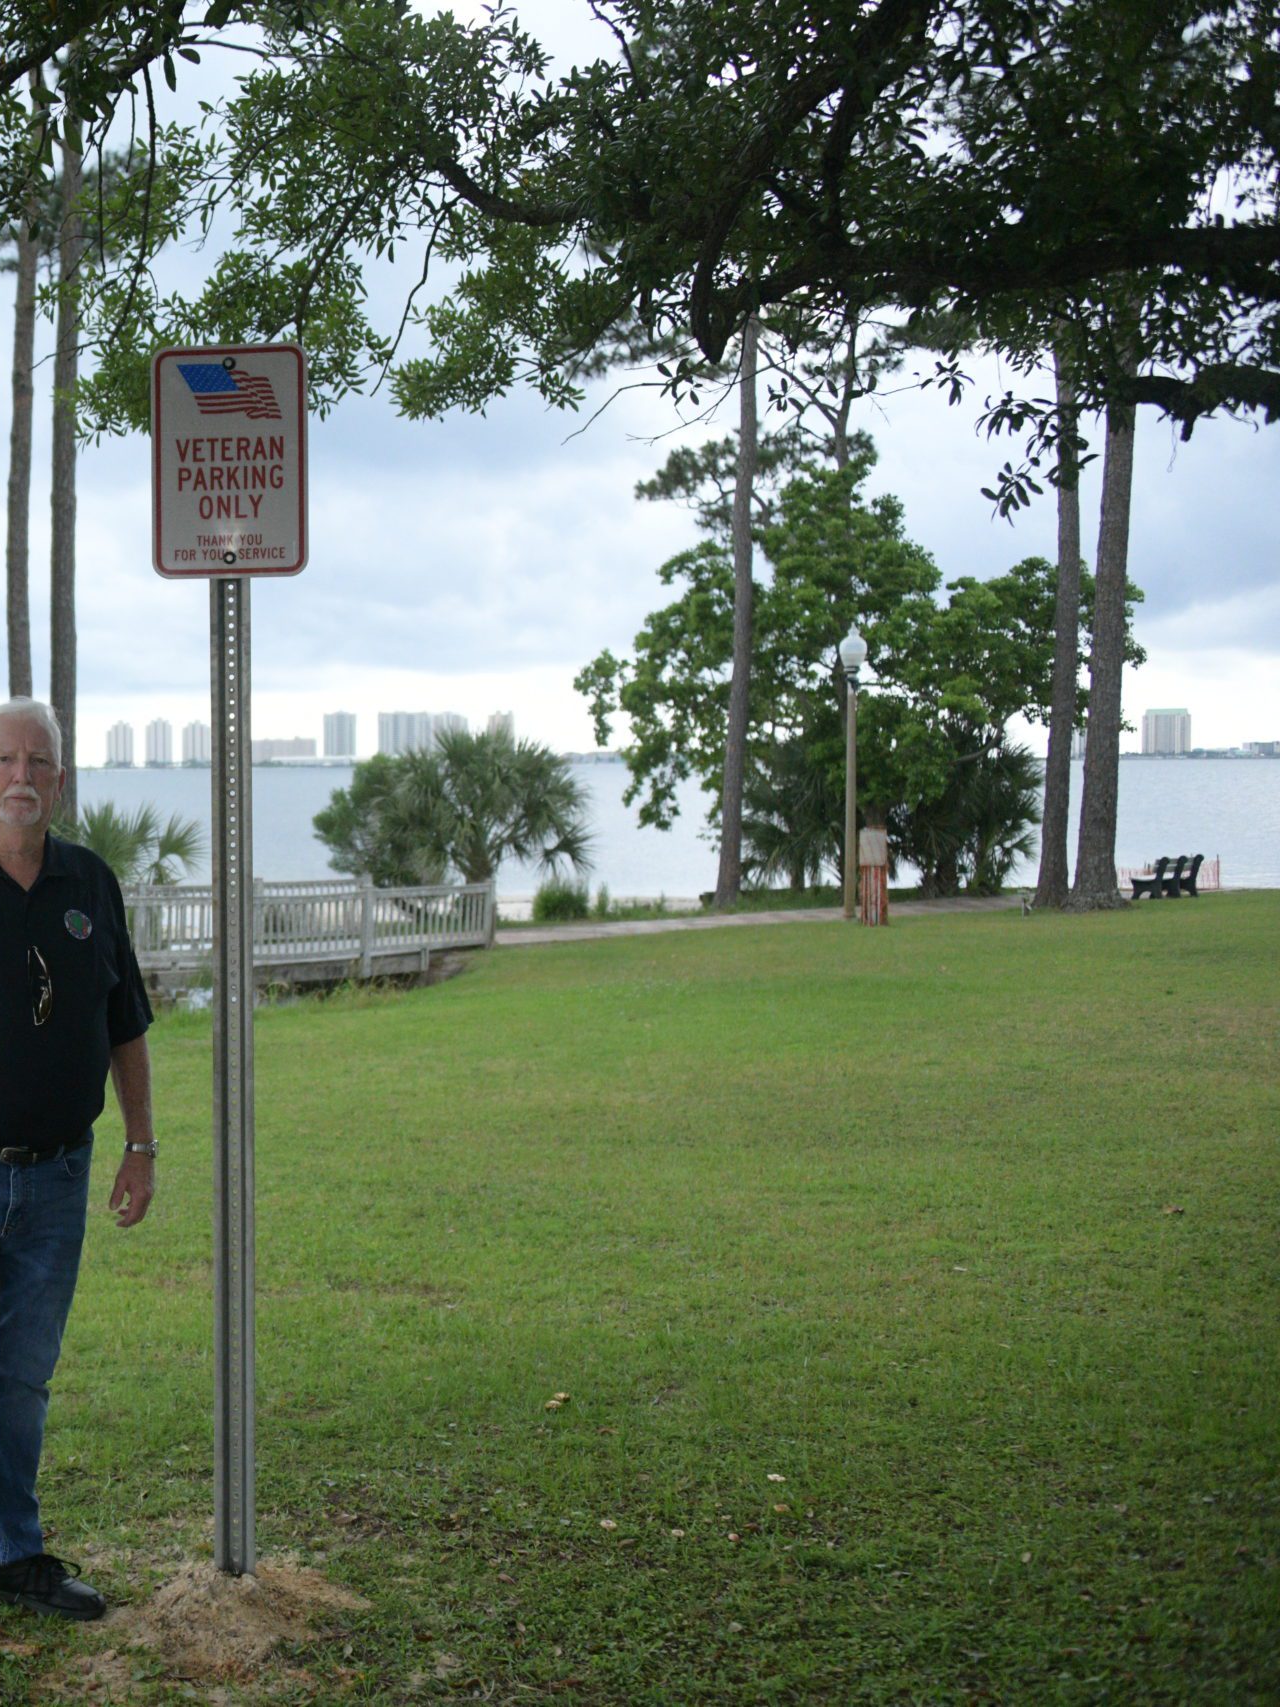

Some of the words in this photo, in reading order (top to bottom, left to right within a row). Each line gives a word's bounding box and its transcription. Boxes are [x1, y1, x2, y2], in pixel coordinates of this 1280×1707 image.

[176, 436, 284, 462] VETERAN
[178, 465, 284, 491] PARKING
[199, 494, 263, 519] ONLY
[197, 534, 233, 547] THANK
[240, 533, 263, 546] YOU
[174, 549, 196, 561] FOR
[202, 548, 235, 561] YOU
[238, 547, 286, 560] SERVICE
